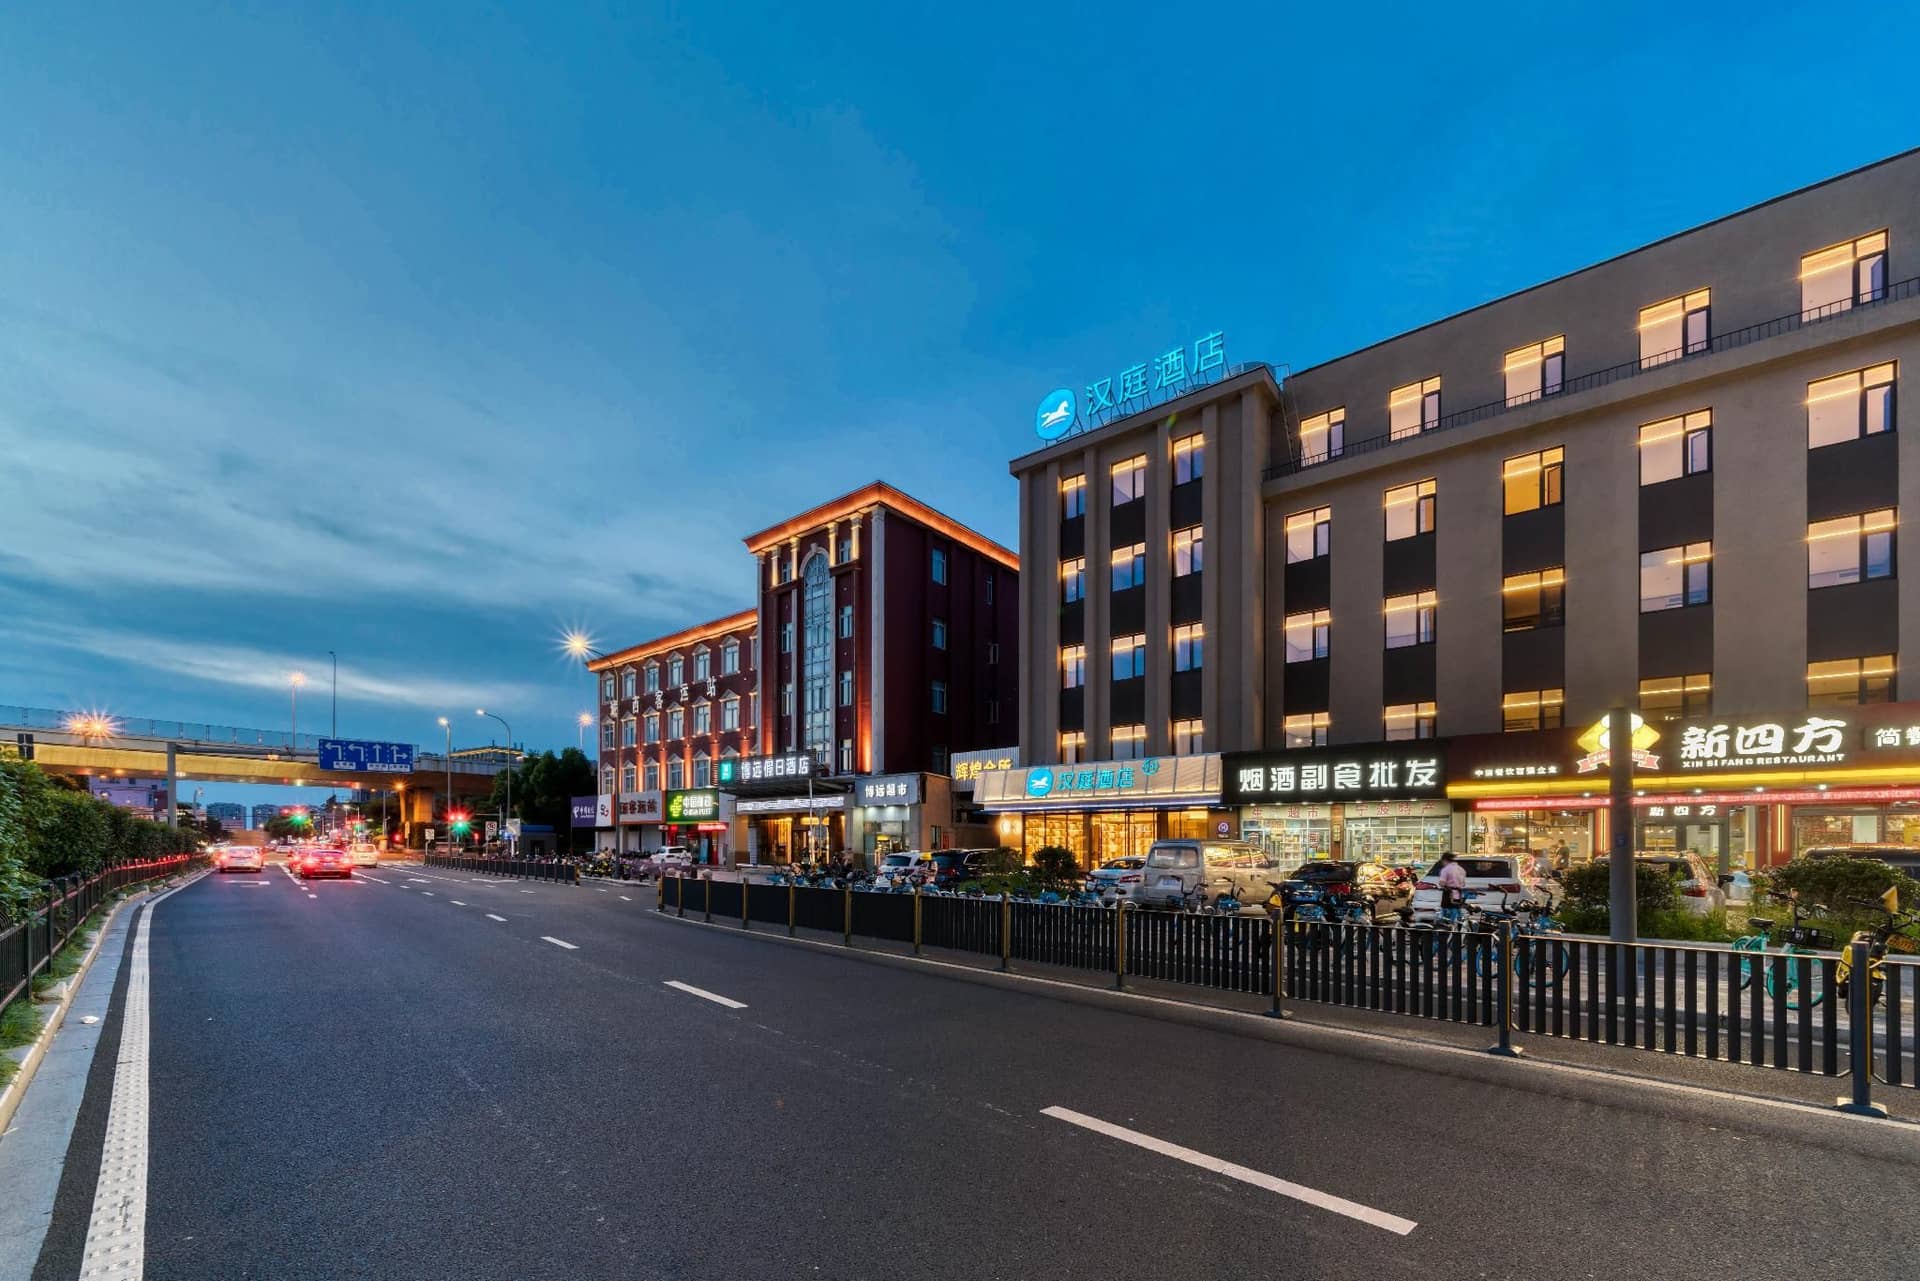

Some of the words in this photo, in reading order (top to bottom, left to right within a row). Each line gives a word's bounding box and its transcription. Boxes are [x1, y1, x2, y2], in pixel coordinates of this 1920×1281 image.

[1086, 331, 1224, 416] 汉庭酒店
[1680, 717, 1847, 759] 新四方
[741, 756, 810, 780] 博远假日酒店
[1720, 758, 1754, 766] FANG
[1756, 753, 1845, 765] RESTAURANT
[1057, 767, 1136, 791] 汉庭酒店
[1239, 758, 1437, 793] 烟酒副食批发
[865, 783, 908, 798] 博远超市
[1649, 805, 1717, 816] 新四方
